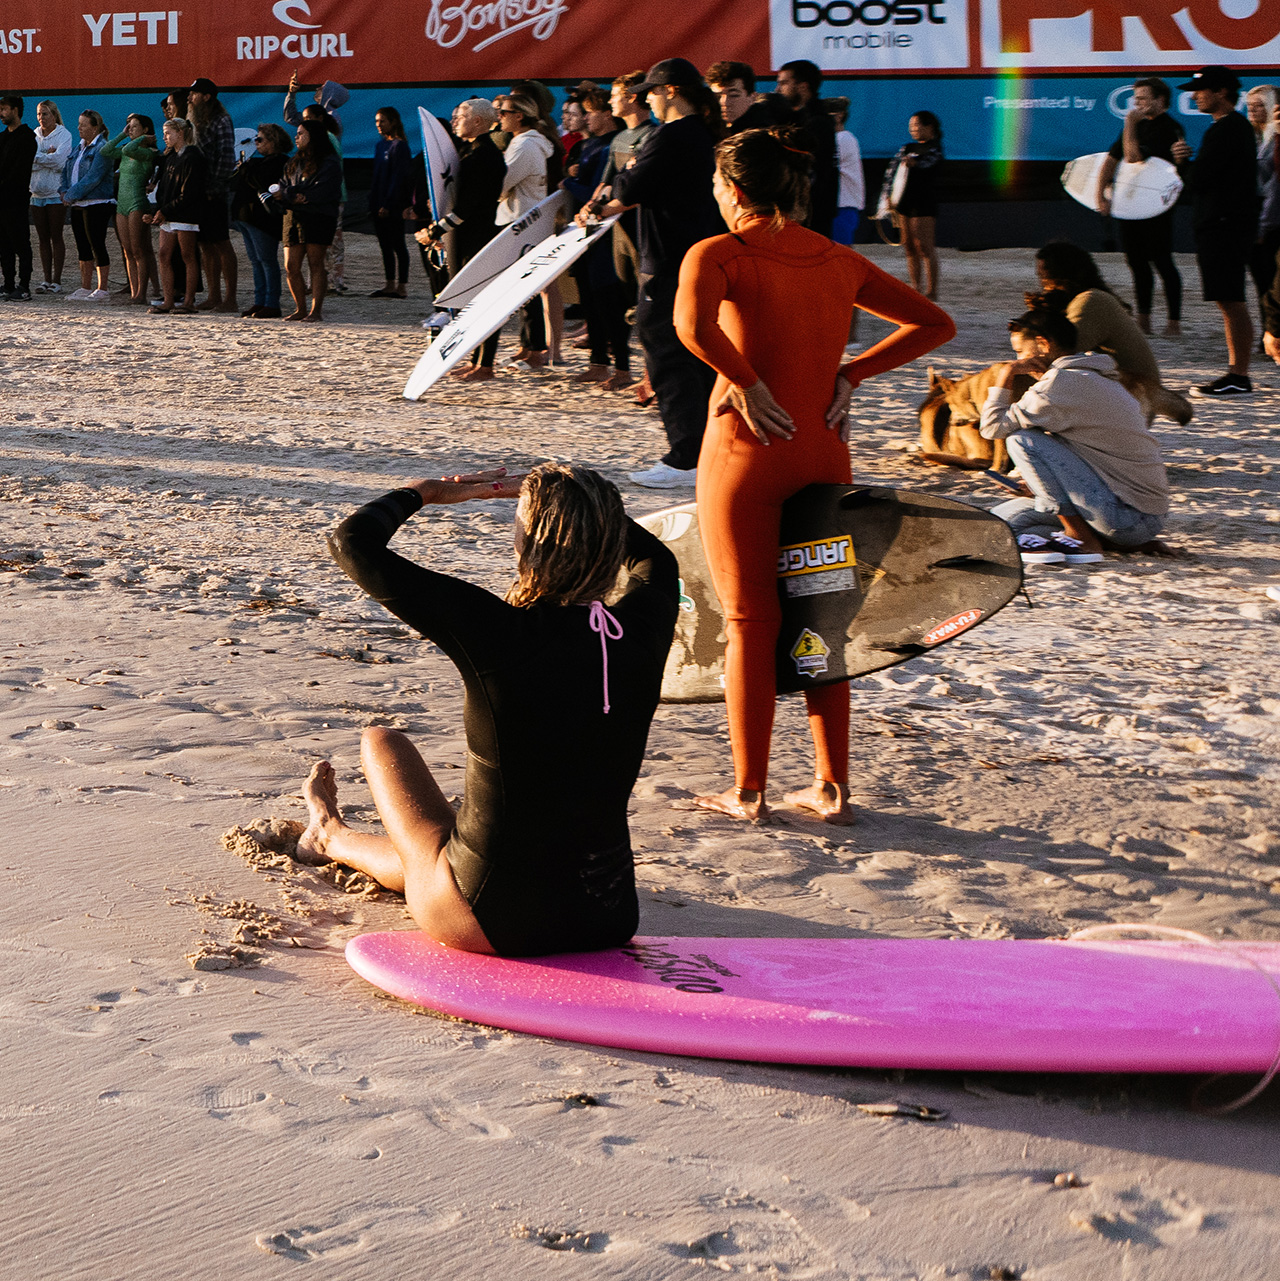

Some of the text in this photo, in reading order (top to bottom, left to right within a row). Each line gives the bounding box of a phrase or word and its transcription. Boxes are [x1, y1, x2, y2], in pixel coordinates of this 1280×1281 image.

[82, 11, 179, 46] YETI
[823, 31, 913, 48] mobile
[237, 33, 354, 60] RIPCURL
[1073, 96, 1097, 111] by
